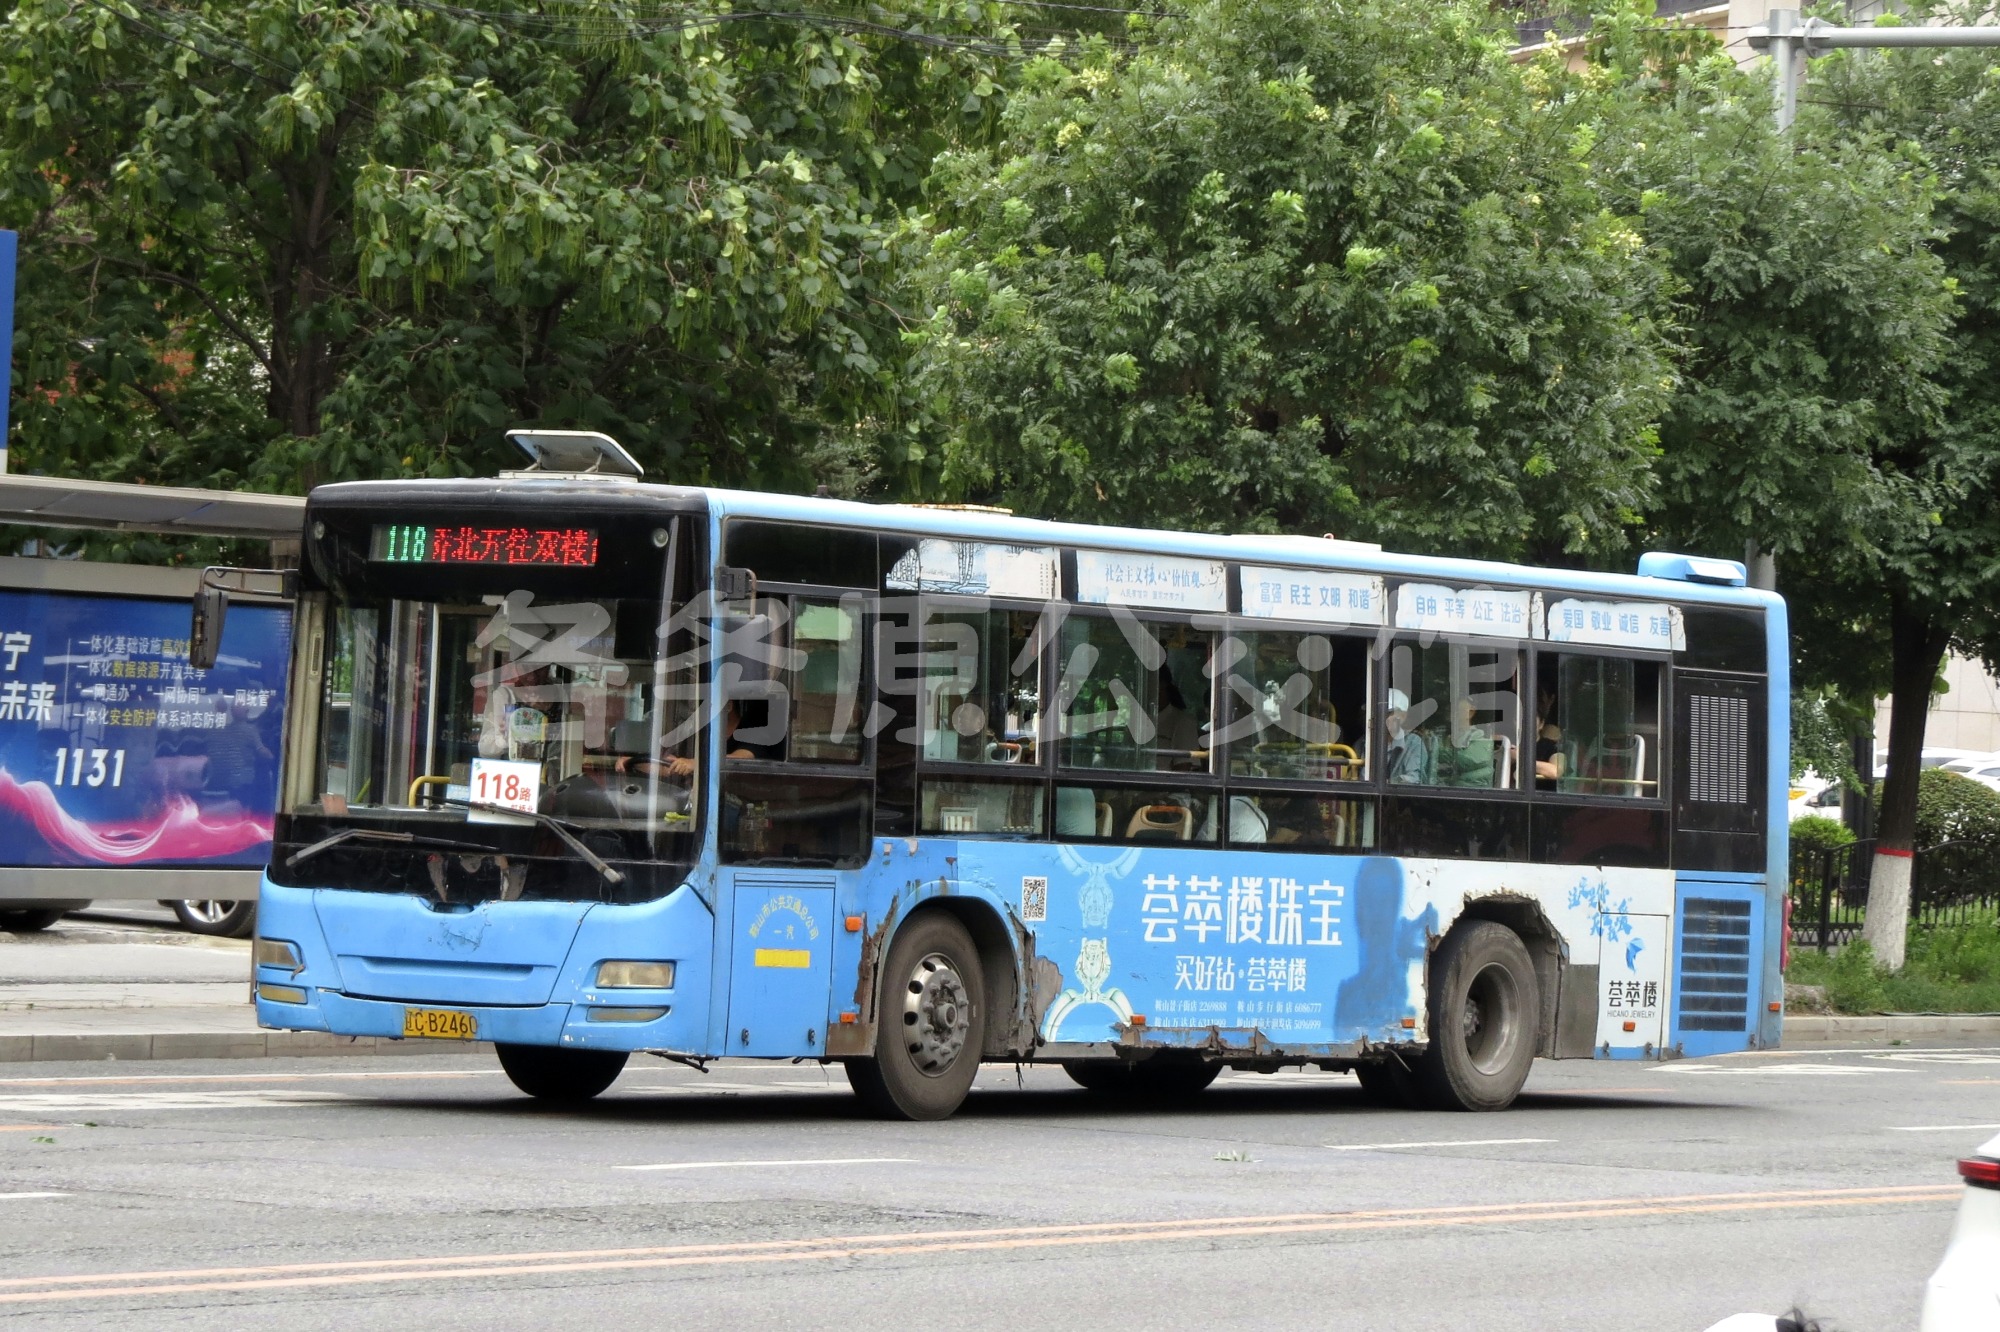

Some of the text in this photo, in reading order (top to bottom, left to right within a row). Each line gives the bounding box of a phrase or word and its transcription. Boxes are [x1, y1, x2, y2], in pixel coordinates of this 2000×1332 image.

[388, 525, 427, 562] 118
[1105, 563, 1200, 588] 社会主义核心价值观
[1260, 582, 1371, 610] 富强 民主 文明 和谐
[1416, 595, 1522, 624] 自由 平等 公正 法治
[1563, 608, 1671, 637] 爱国 敬业 诚信 友善
[55, 747, 125, 787] 1131
[1141, 873, 1345, 946] 荟萃楼珠宝
[1609, 980, 1658, 1008] 荟萃楼
